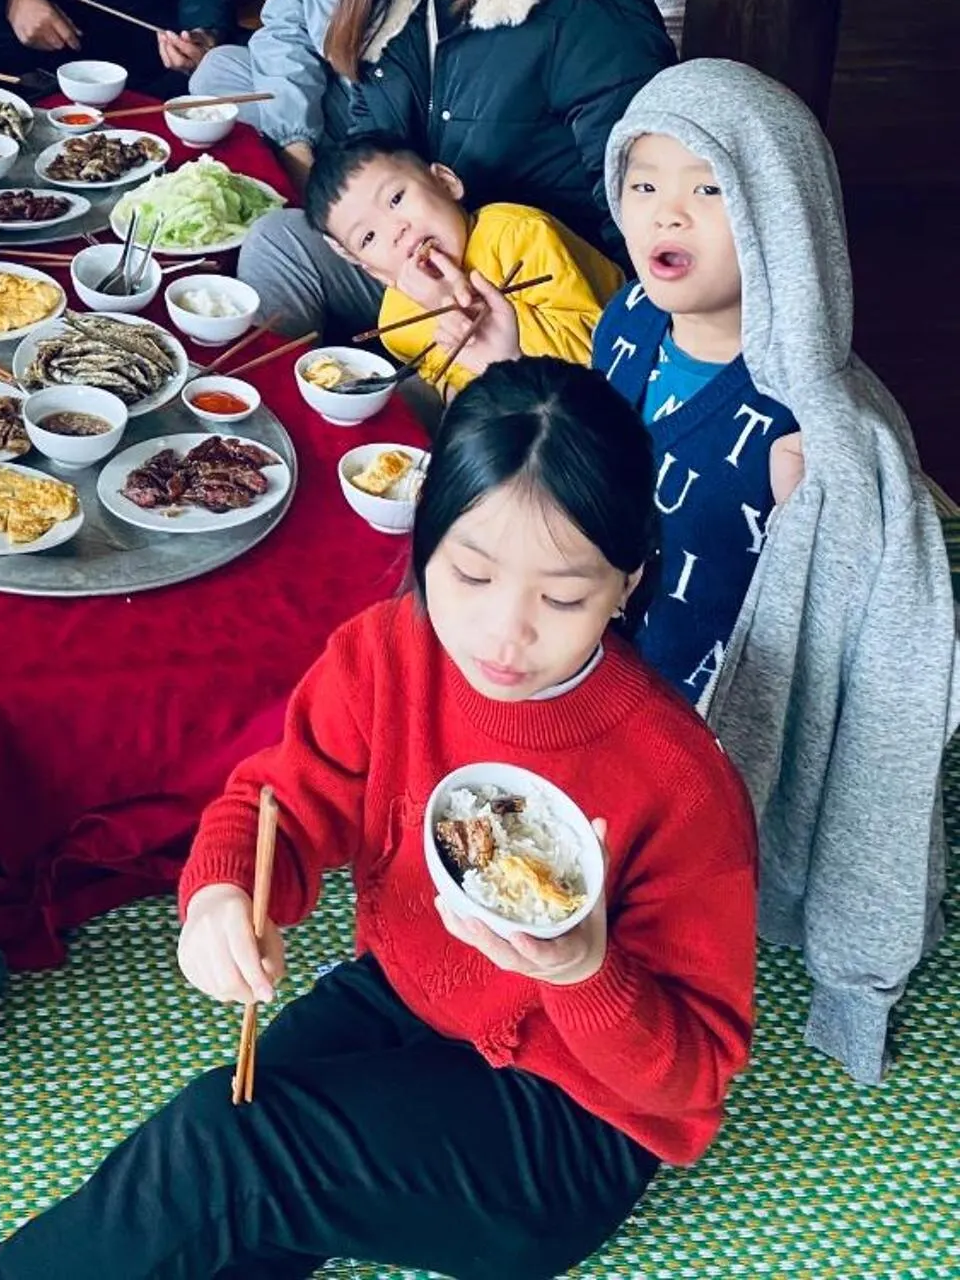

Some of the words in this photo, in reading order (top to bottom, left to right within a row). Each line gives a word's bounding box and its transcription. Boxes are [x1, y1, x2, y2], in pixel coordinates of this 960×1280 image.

[606, 335, 637, 381] T
[724, 403, 775, 470] T
[654, 453, 701, 515] U
[668, 550, 699, 604] I
